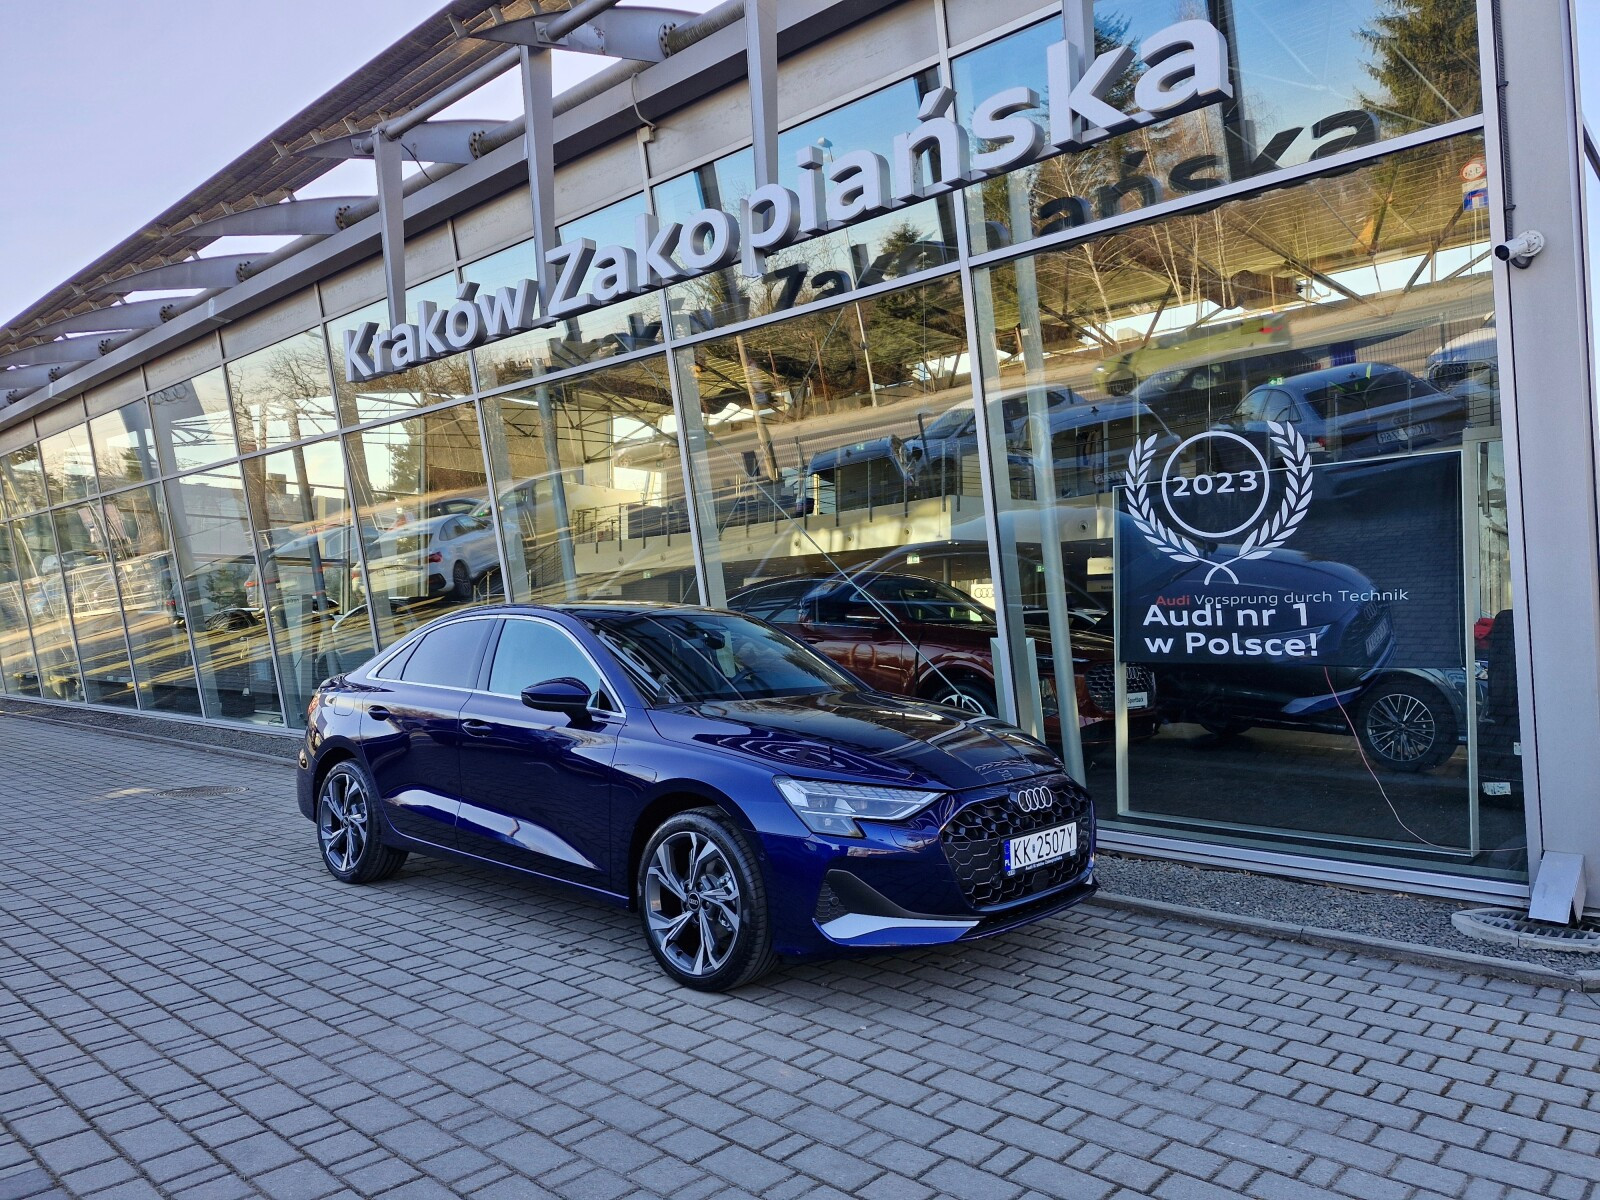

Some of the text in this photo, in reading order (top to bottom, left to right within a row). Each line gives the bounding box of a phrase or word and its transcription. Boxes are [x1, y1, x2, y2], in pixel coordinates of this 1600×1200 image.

[344, 19, 1230, 382] Kraków Zakopiańska
[1172, 470, 1258, 497] 2023
[1155, 588, 1409, 607] Audi Vorsprung durch Technik
[1143, 602, 1308, 626] Audi nr 1
[1144, 632, 1318, 657] w Polsce!
[1013, 837, 1032, 867] KK
[1036, 826, 1073, 859] 2507Y
